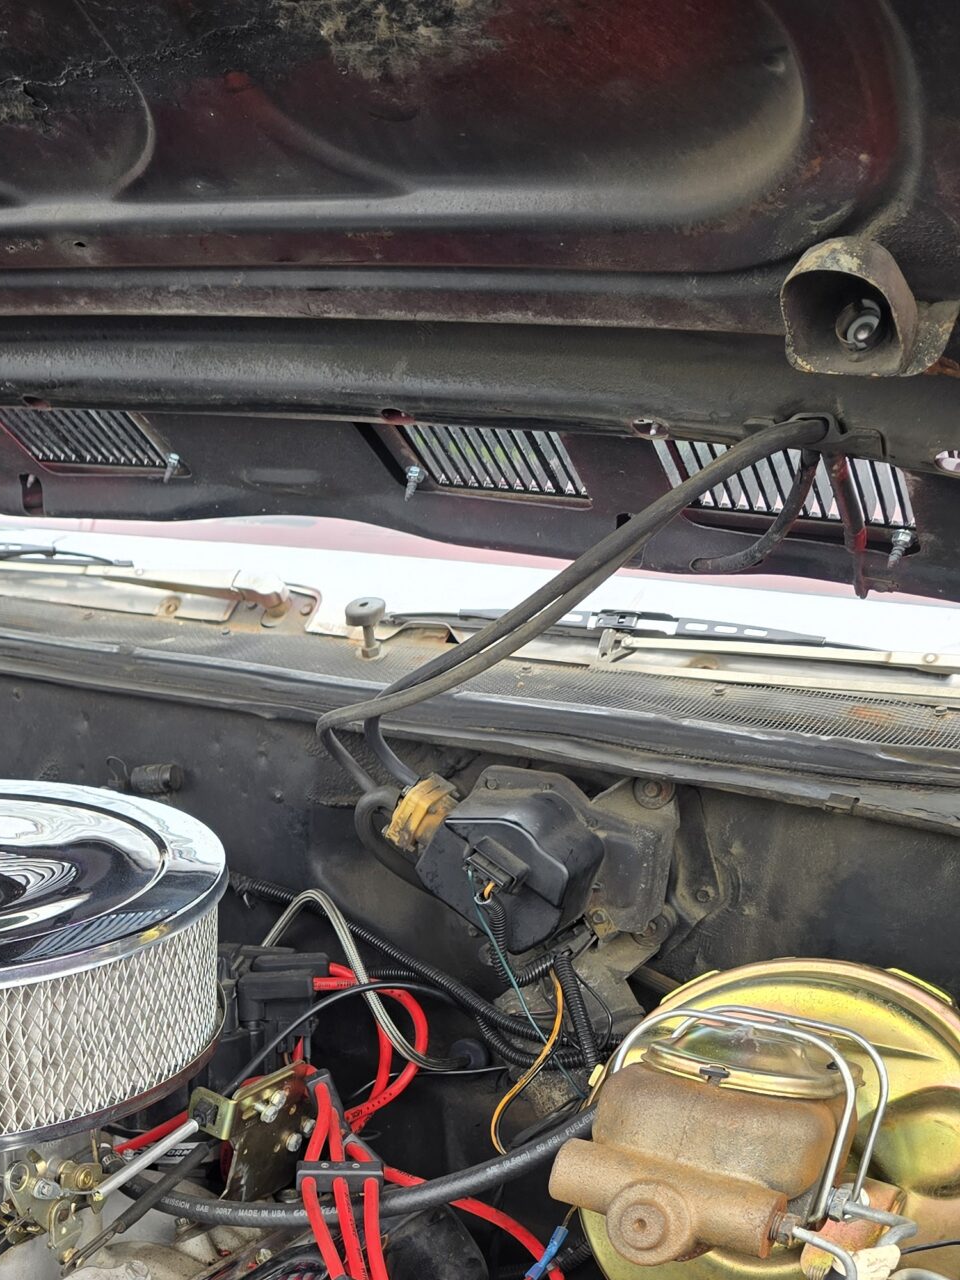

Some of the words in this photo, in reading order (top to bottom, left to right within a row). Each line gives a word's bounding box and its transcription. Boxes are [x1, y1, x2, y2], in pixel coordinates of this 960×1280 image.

[547, 1135, 562, 1147] PSI
[238, 1209, 259, 1217] MADE
[261, 1209, 270, 1218] IN
[271, 1209, 286, 1218] USA
